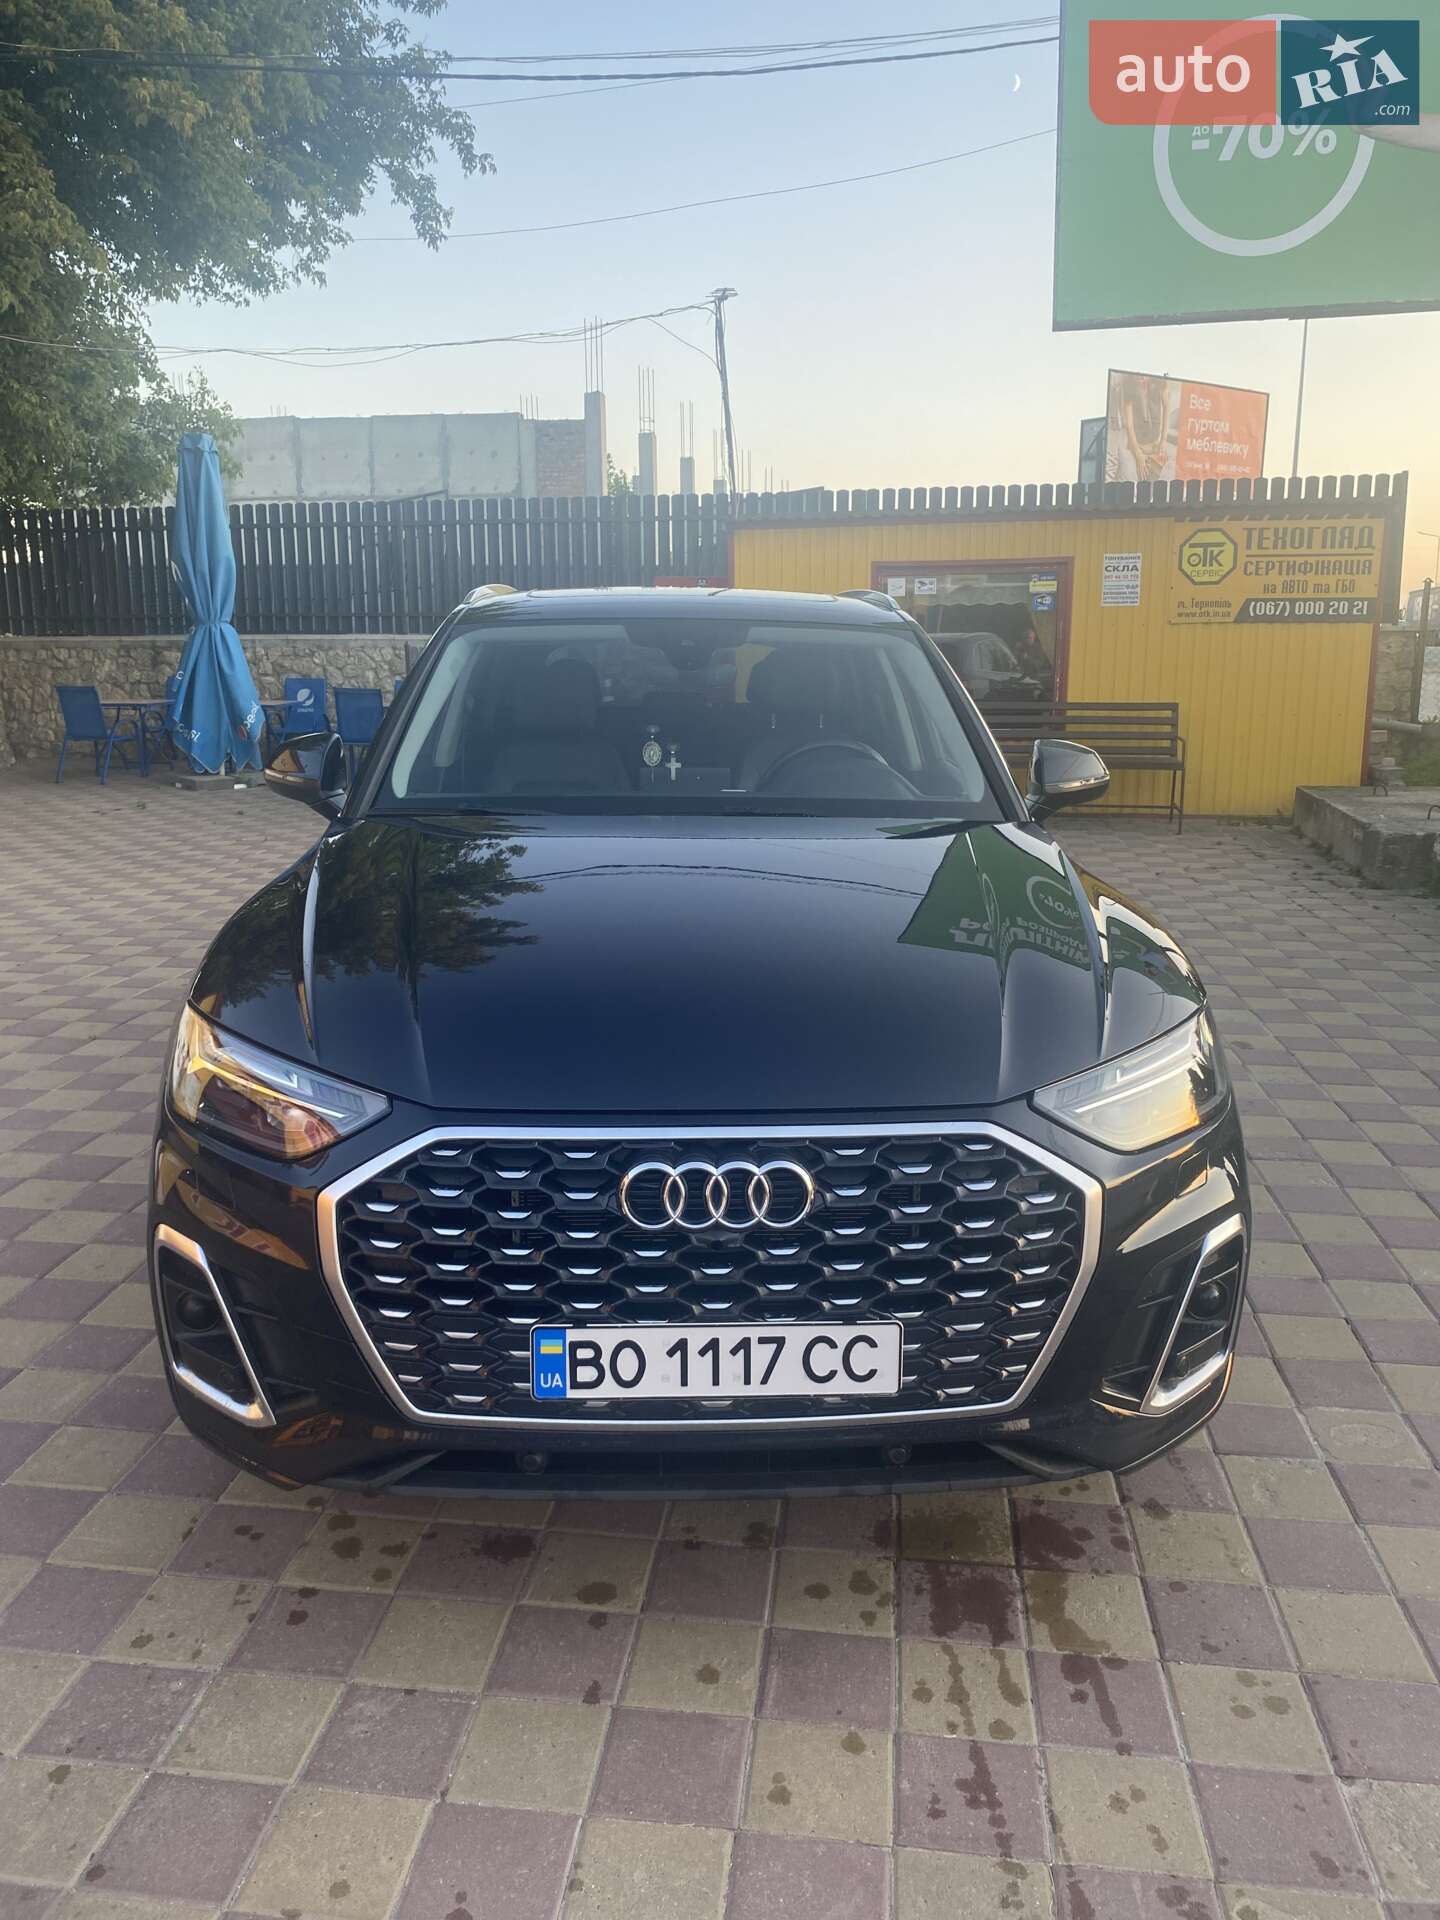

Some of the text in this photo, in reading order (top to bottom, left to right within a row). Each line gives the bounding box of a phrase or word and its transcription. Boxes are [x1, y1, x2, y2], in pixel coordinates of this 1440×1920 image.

[1189, 394, 1211, 411] Все
[1187, 417, 1229, 434] гуртом
[1243, 526, 1375, 550] ТЕХОГЛЯД
[1104, 564, 1139, 573] СКЛА
[1243, 559, 1372, 576] СЕРТИФІКАЦІЯ
[1281, 580, 1308, 594] АВТО
[1335, 580, 1356, 594] ГБО
[1249, 601, 1368, 617] (067) 000 20 21
[568, 1334, 879, 1389] BO 1117 CC
[540, 1374, 562, 1389] UA
